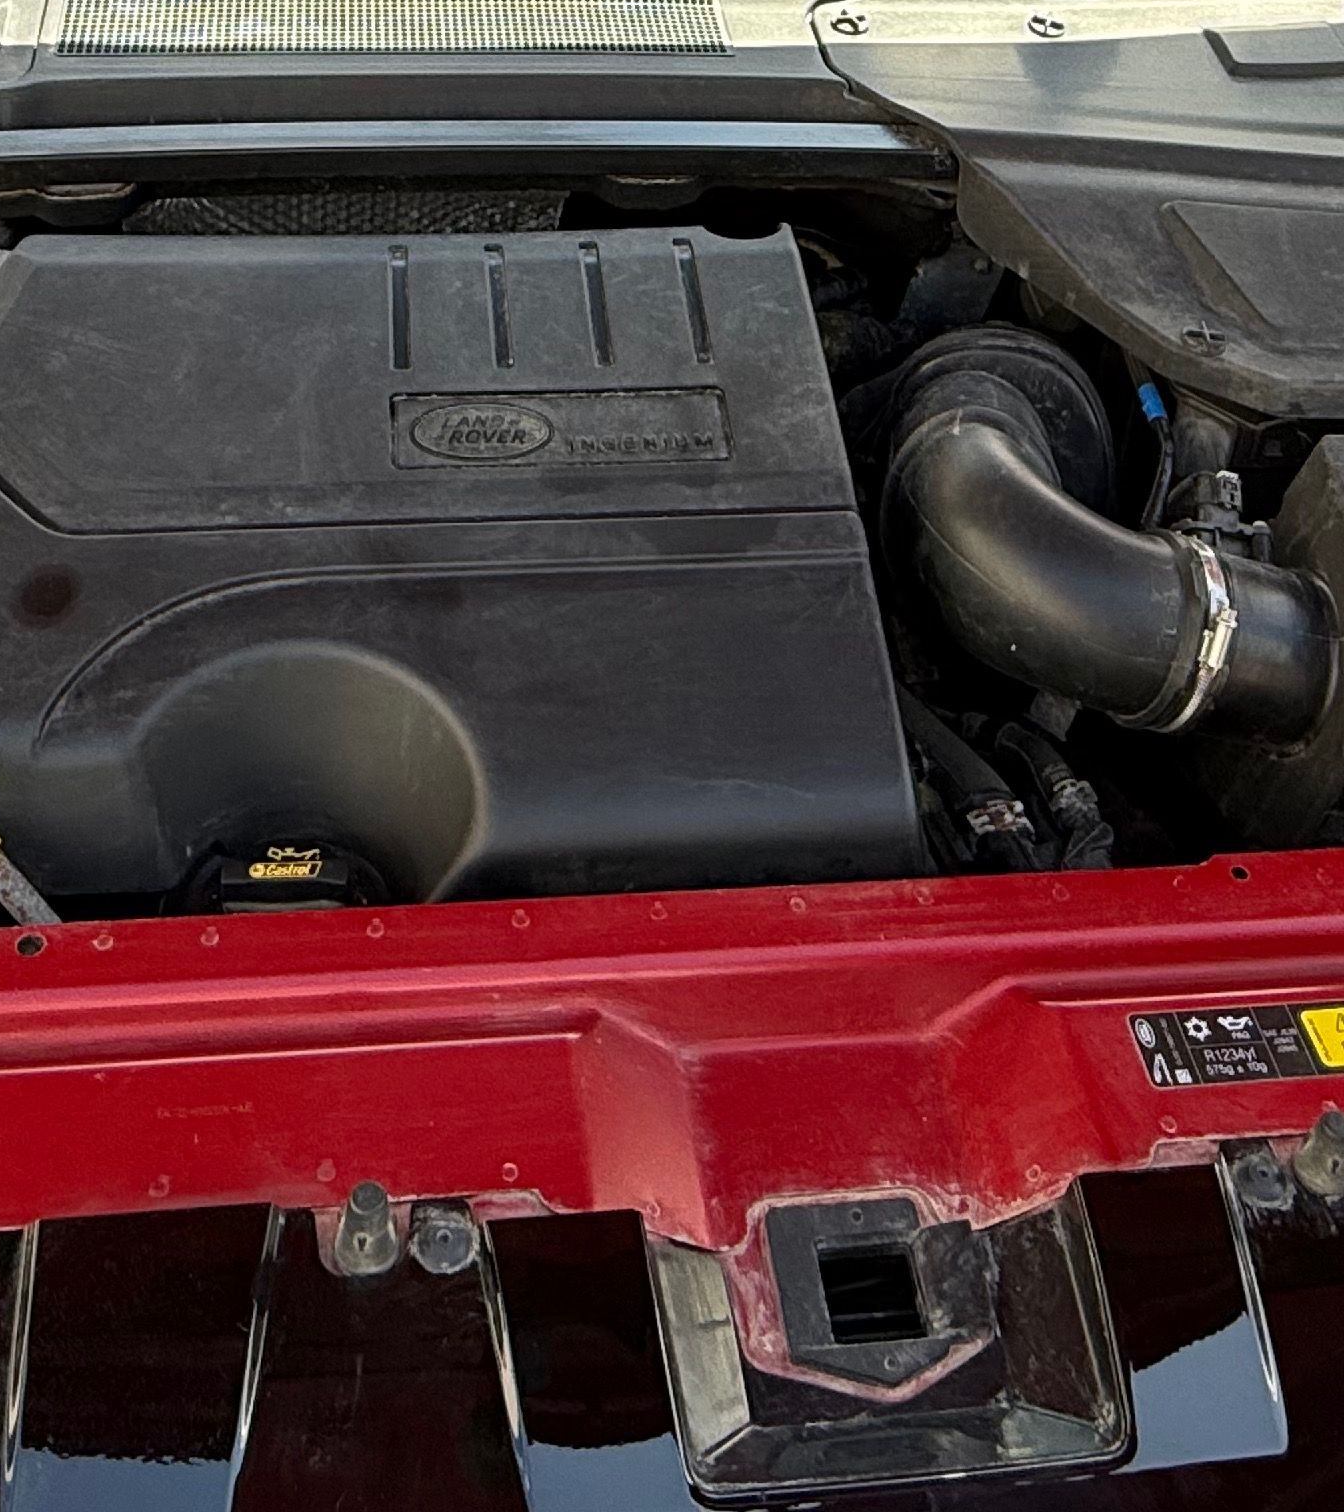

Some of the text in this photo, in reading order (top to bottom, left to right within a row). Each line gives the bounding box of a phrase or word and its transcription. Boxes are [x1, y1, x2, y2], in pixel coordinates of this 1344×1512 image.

[440, 414, 506, 430] LAND
[448, 429, 527, 446] ROVER
[567, 433, 714, 455] INGENIUM
[266, 863, 312, 876] Castrol
